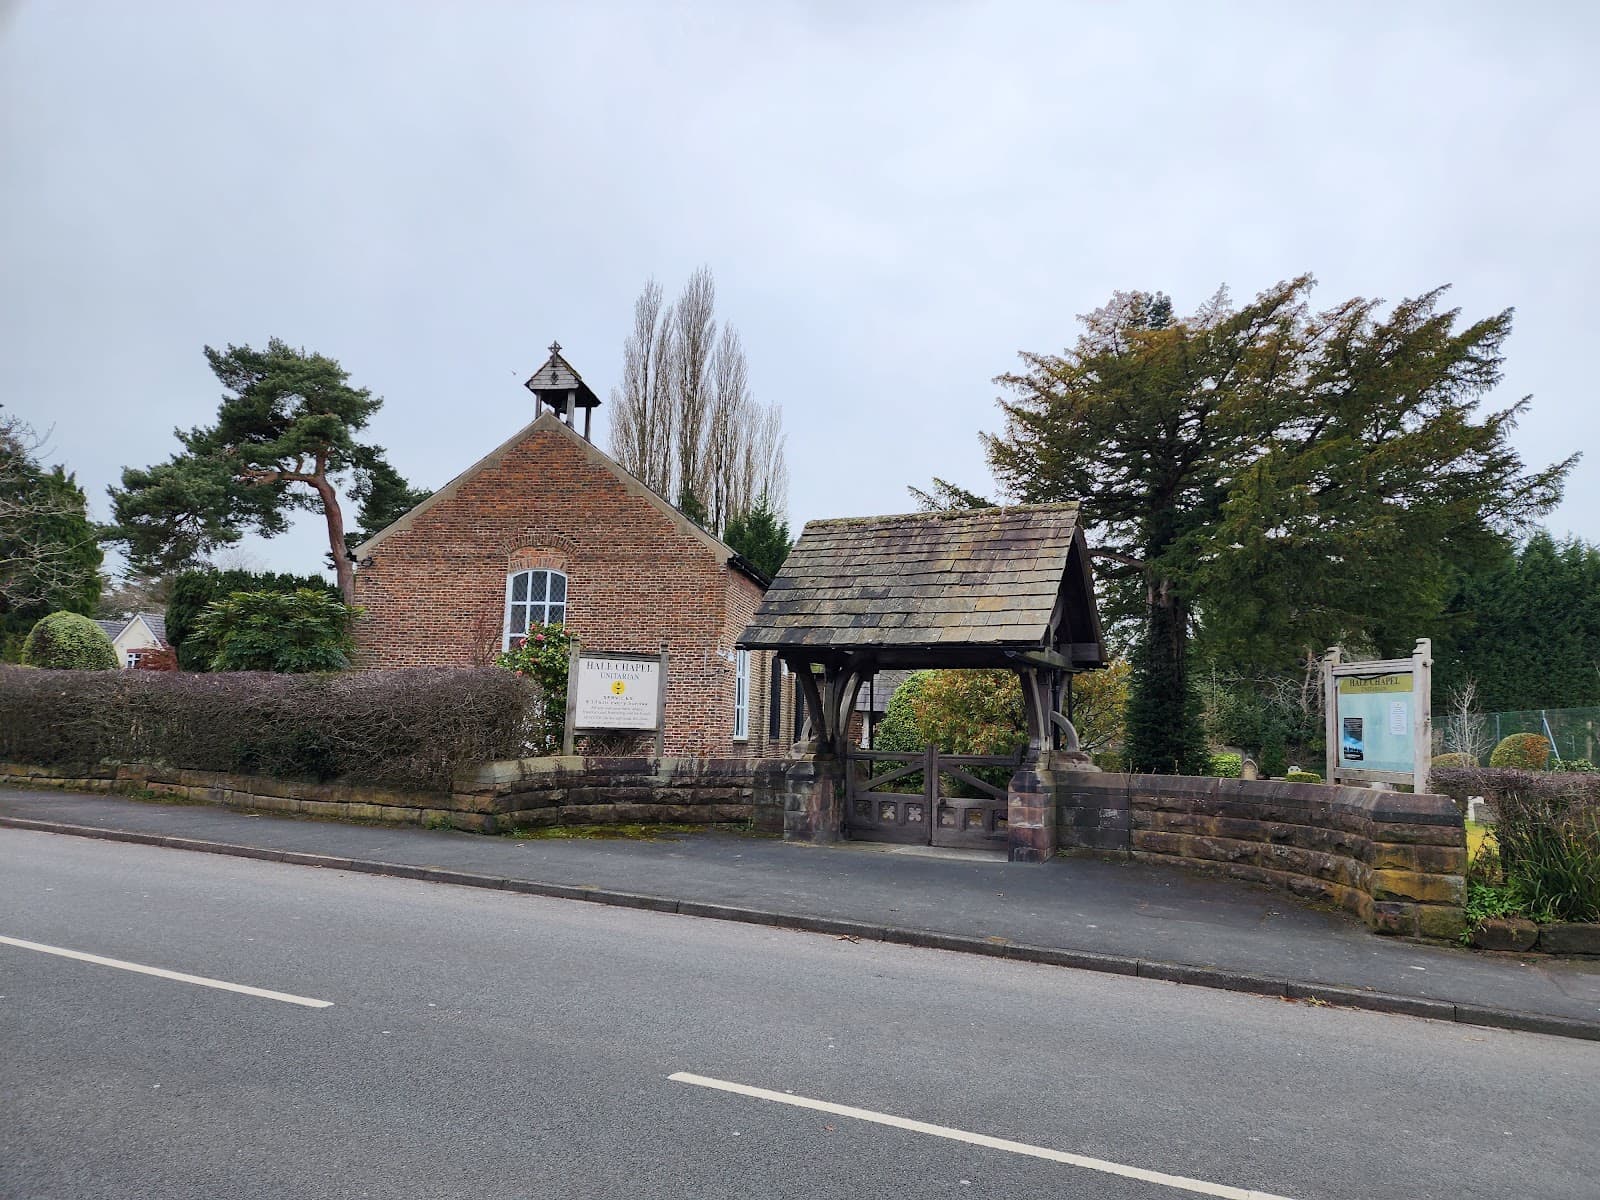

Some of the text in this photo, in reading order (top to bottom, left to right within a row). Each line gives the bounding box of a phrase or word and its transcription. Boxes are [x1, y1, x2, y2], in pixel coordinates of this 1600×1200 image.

[587, 661, 653, 672] HALE CHAPEL
[1369, 677, 1400, 686] CHAPEL
